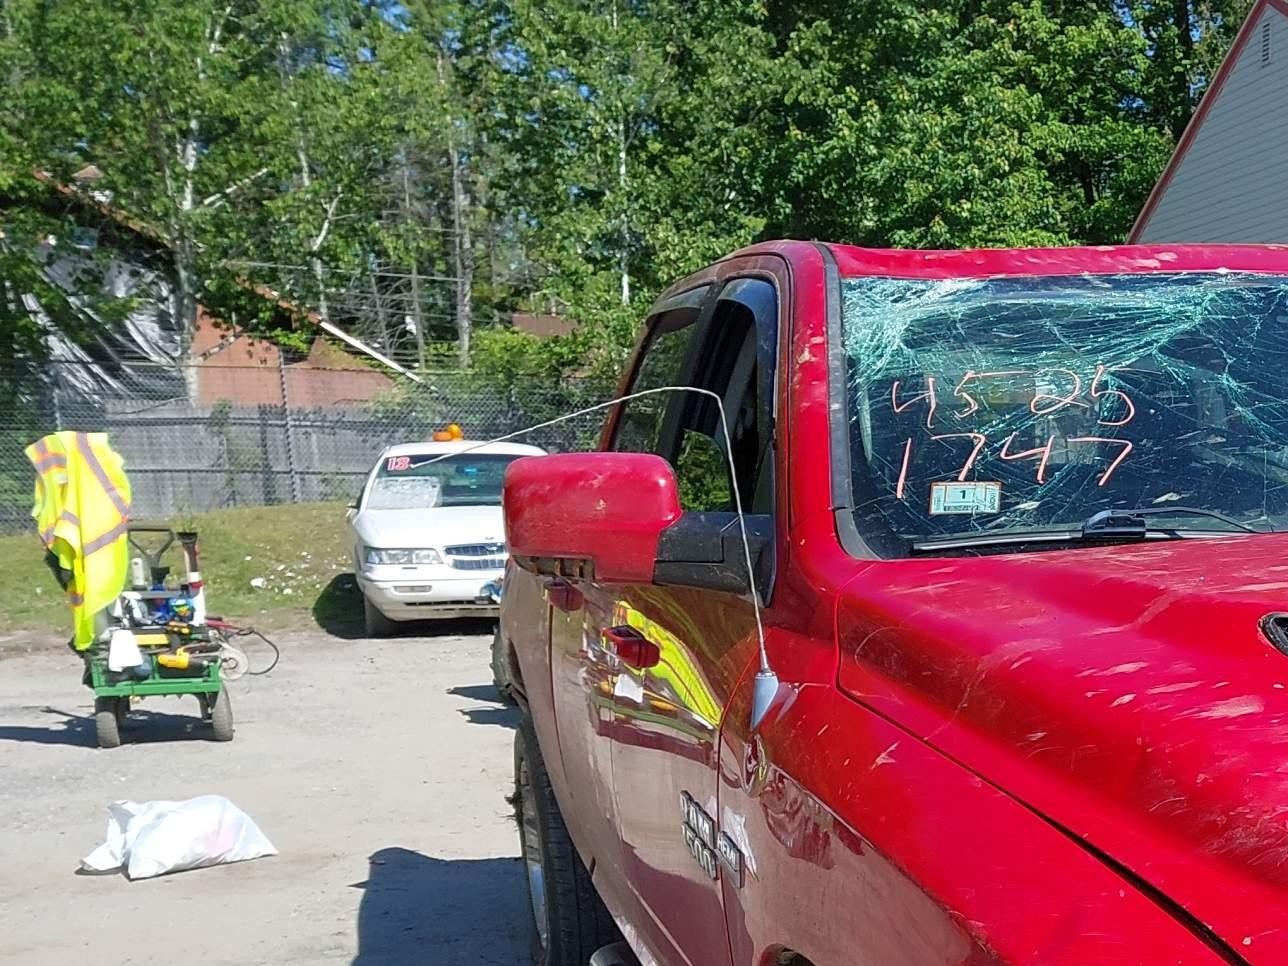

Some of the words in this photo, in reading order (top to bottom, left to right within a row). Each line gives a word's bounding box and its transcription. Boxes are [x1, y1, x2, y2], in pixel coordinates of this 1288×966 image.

[891, 365, 1161, 428] 4525
[896, 432, 1133, 499] 1747
[959, 490, 967, 499] 1
[680, 791, 714, 850] RAM
[681, 822, 718, 880] 1500
[717, 831, 738, 872] HEMI
